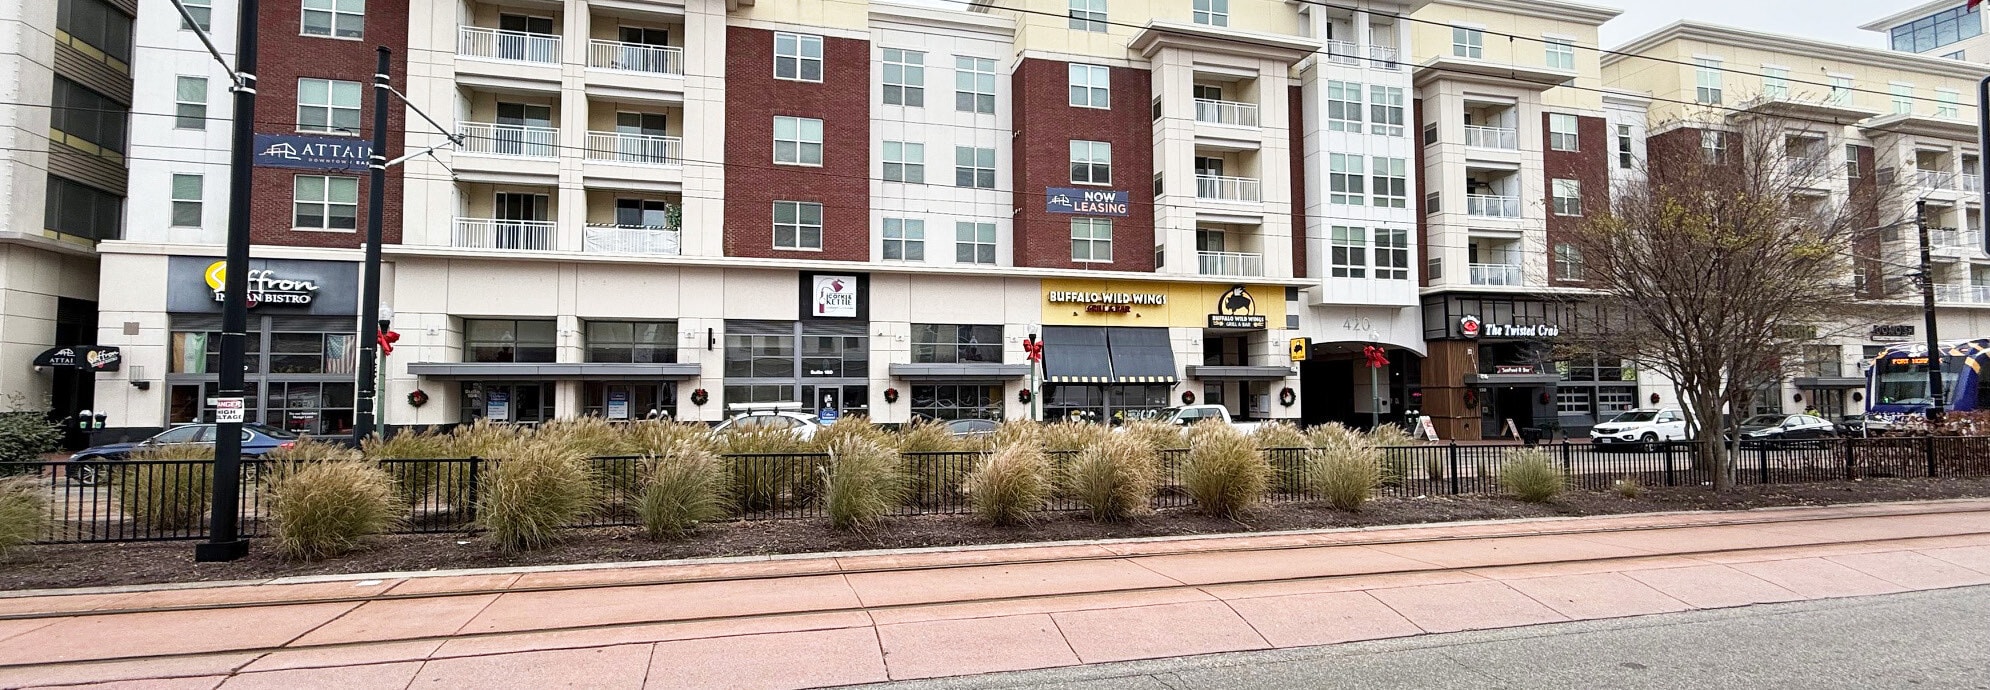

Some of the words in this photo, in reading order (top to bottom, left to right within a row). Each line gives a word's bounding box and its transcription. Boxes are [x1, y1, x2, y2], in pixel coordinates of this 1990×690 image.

[1084, 191, 1116, 203] NOW
[1074, 201, 1126, 214] LEASING
[211, 261, 319, 293] Sffron
[215, 292, 262, 302] INAN
[265, 293, 312, 304] BISTRO
[1049, 290, 1099, 303] BUFFALO
[1101, 292, 1131, 304] WILD
[1132, 293, 1167, 305] WINGS
[1342, 317, 1371, 332] 420
[1485, 324, 1503, 336] The
[1504, 324, 1536, 336] Twisted
[1538, 325, 1559, 337] Crab
